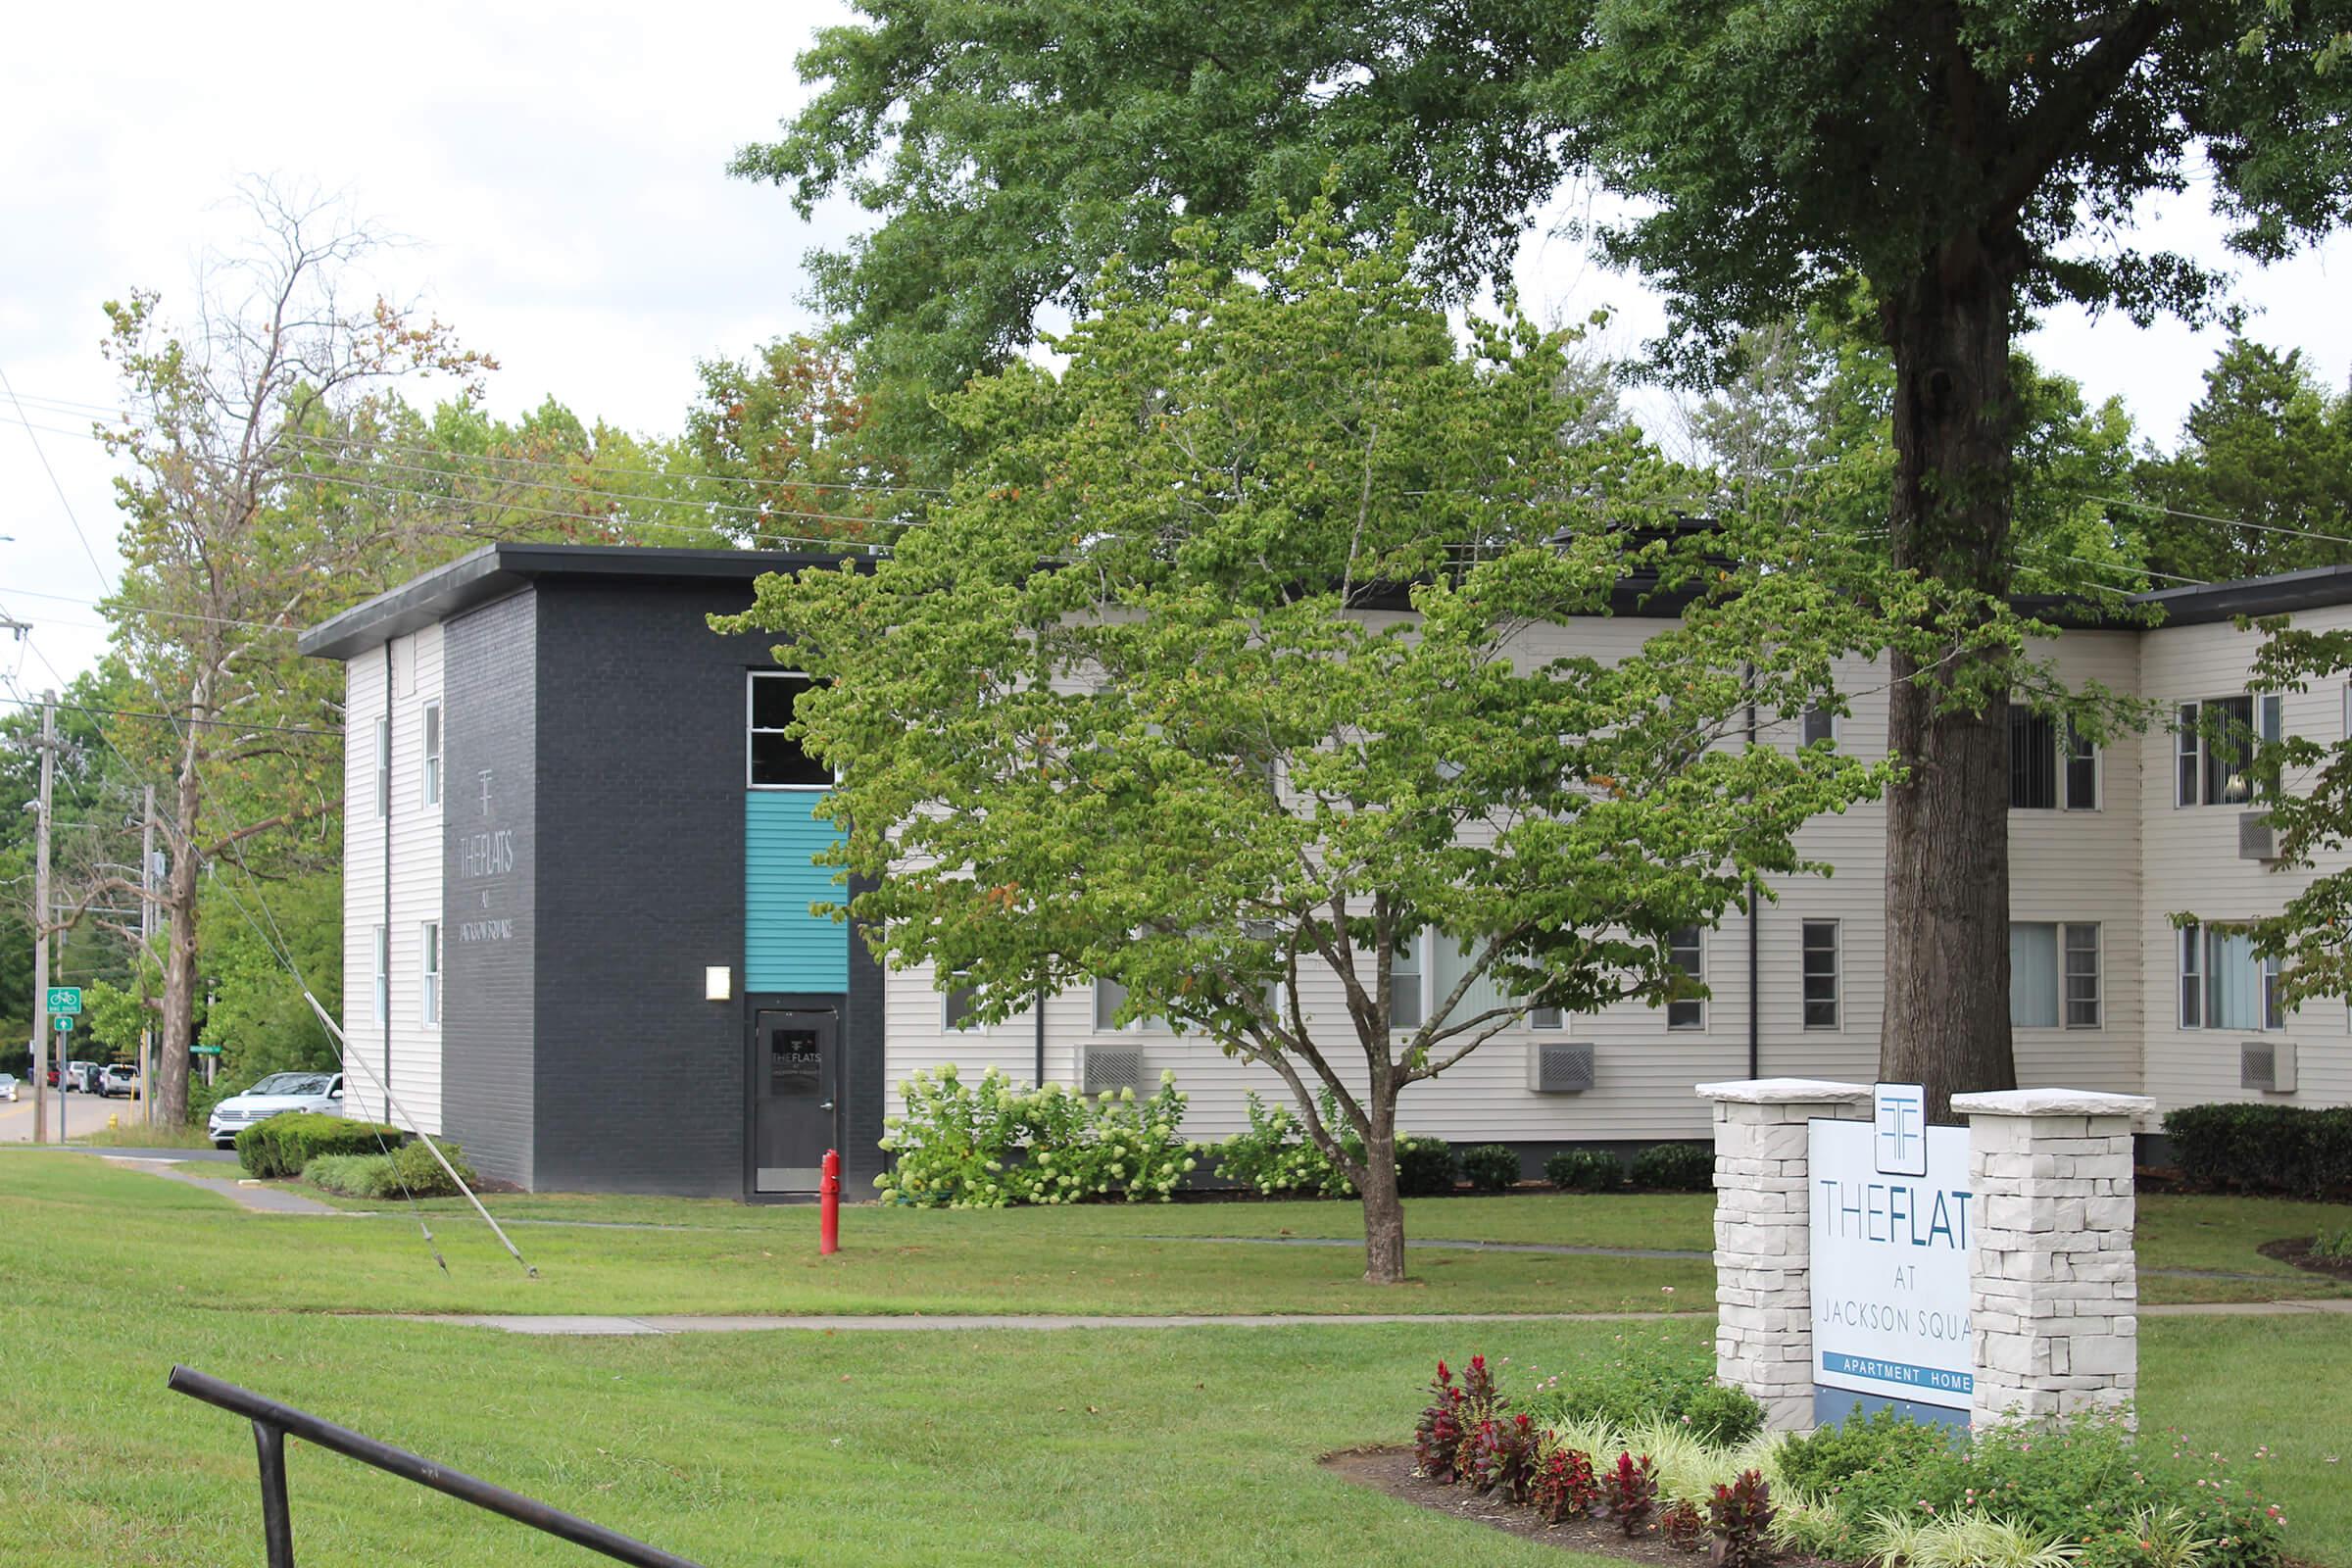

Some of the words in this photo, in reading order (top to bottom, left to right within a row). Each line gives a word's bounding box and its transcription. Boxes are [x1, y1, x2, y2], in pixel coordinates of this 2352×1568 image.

[1820, 1180, 1973, 1250] THEFLAT
[1893, 1265, 1916, 1291] AT
[1823, 1298, 1909, 1334] JACKSON
[1918, 1310, 1972, 1342] SQUA
[1843, 1358, 1920, 1382] APARTMENT
[1931, 1373, 1972, 1390] HOME
